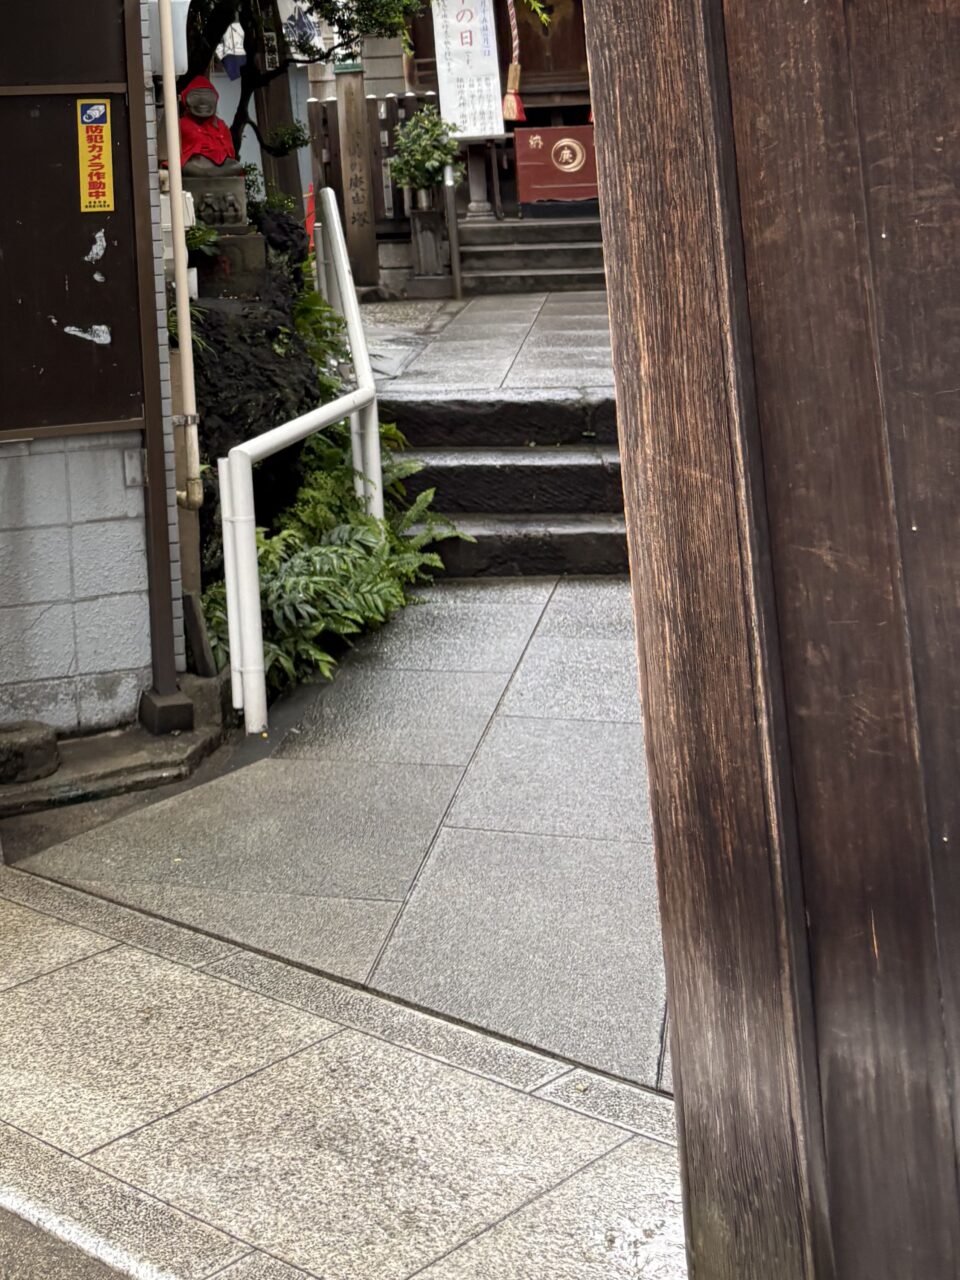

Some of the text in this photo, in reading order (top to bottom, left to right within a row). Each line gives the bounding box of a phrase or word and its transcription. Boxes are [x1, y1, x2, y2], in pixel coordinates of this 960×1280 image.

[85, 125, 107, 200] 防犯カメラ作動中
